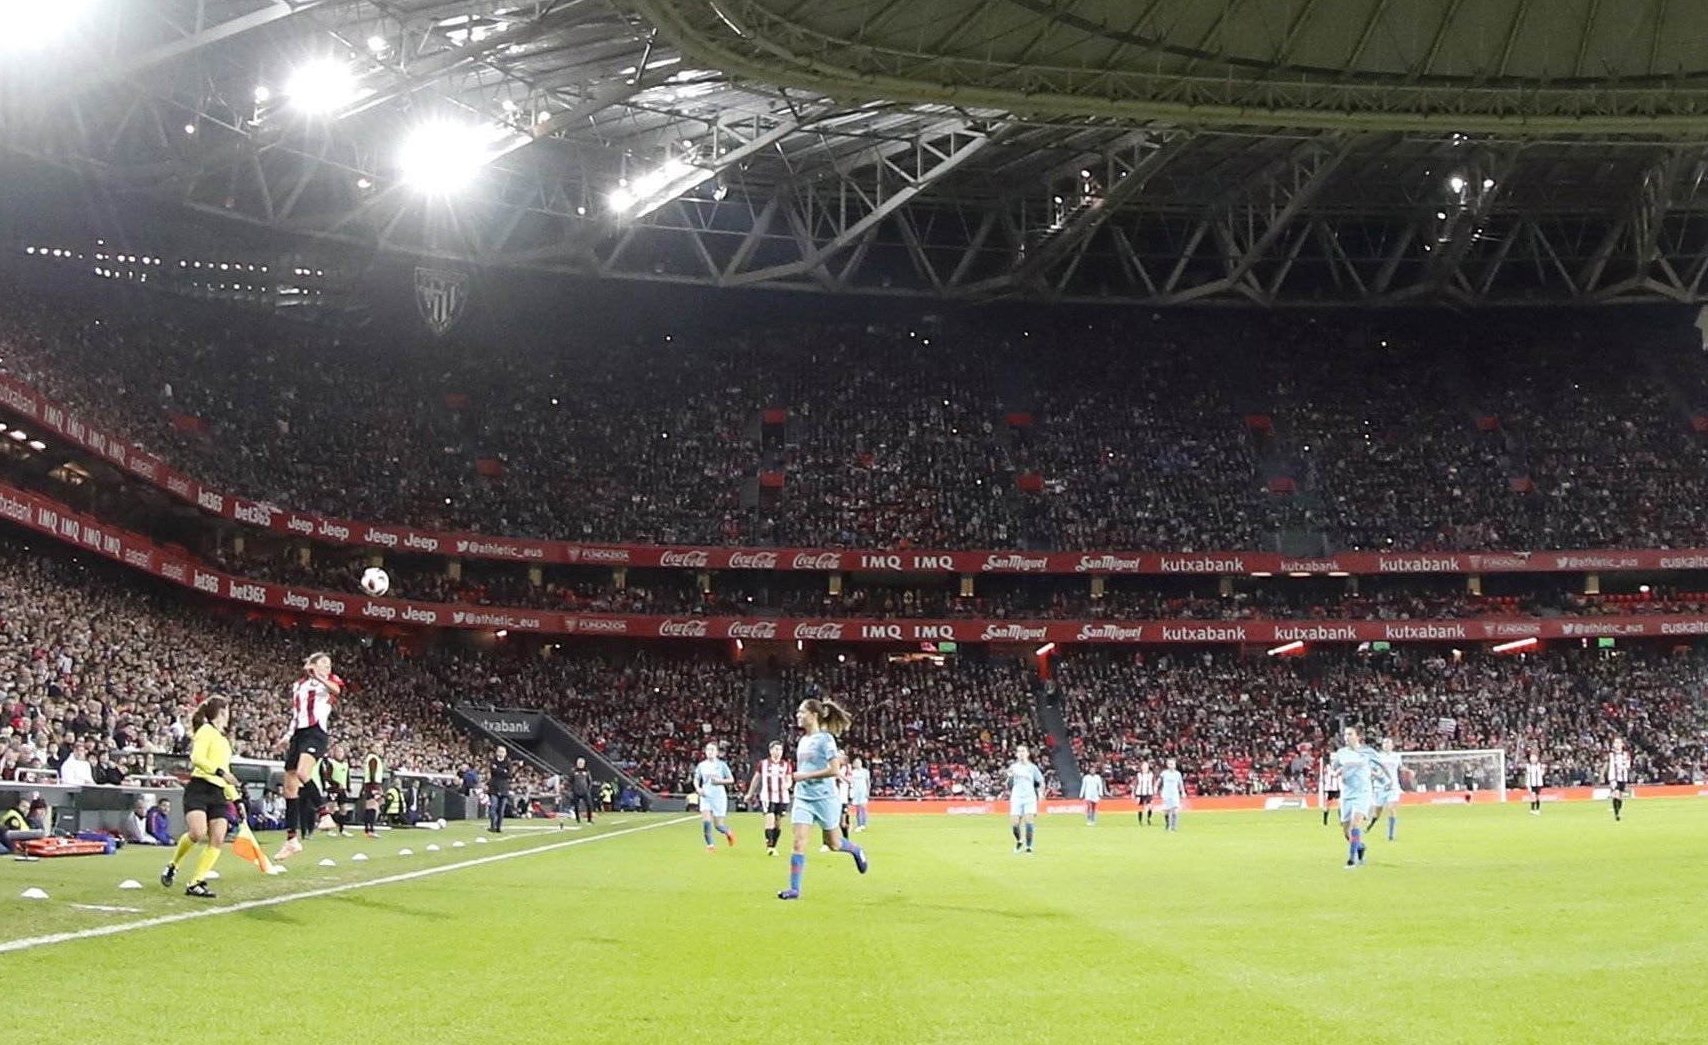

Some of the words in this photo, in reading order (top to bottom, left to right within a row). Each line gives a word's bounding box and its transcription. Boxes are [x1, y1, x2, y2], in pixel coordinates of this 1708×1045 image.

[44, 404, 63, 433] IMQ
[67, 417, 85, 444] IMQ
[88, 428, 105, 455] IMQ
[109, 441, 126, 465] IMQ
[197, 487, 223, 512] bet365
[39, 507, 57, 534] IMQ
[234, 502, 271, 527] bet365
[61, 517, 79, 541] IMQ
[287, 515, 314, 535] Jeep
[319, 521, 349, 541] Jeep
[83, 527, 102, 550] IMQ
[104, 535, 121, 557] IMQ
[364, 528, 398, 547] Jeep
[404, 533, 438, 552] Jeep
[469, 543, 543, 558] @athletic_eus
[862, 555, 902, 570] IMQ
[914, 555, 955, 571] IMQ
[1161, 558, 1244, 572] kutxabank
[1281, 560, 1339, 572] kutxabank
[1380, 557, 1459, 572] kutxabank
[1568, 557, 1638, 569] @athletic_eus
[230, 581, 266, 604] bet365
[283, 590, 309, 609] Jeep
[314, 596, 345, 614] Jeep
[363, 602, 396, 620] Jeep
[402, 606, 436, 624] Jeep
[465, 613, 540, 628] @athletic_eus
[862, 625, 903, 640] IMQ
[914, 625, 955, 640] IMQ
[1163, 626, 1246, 640] kutxabank
[1275, 625, 1356, 640] kutxabank
[1386, 624, 1465, 639] kutxabank
[1574, 623, 1643, 634] @athletic_eus
